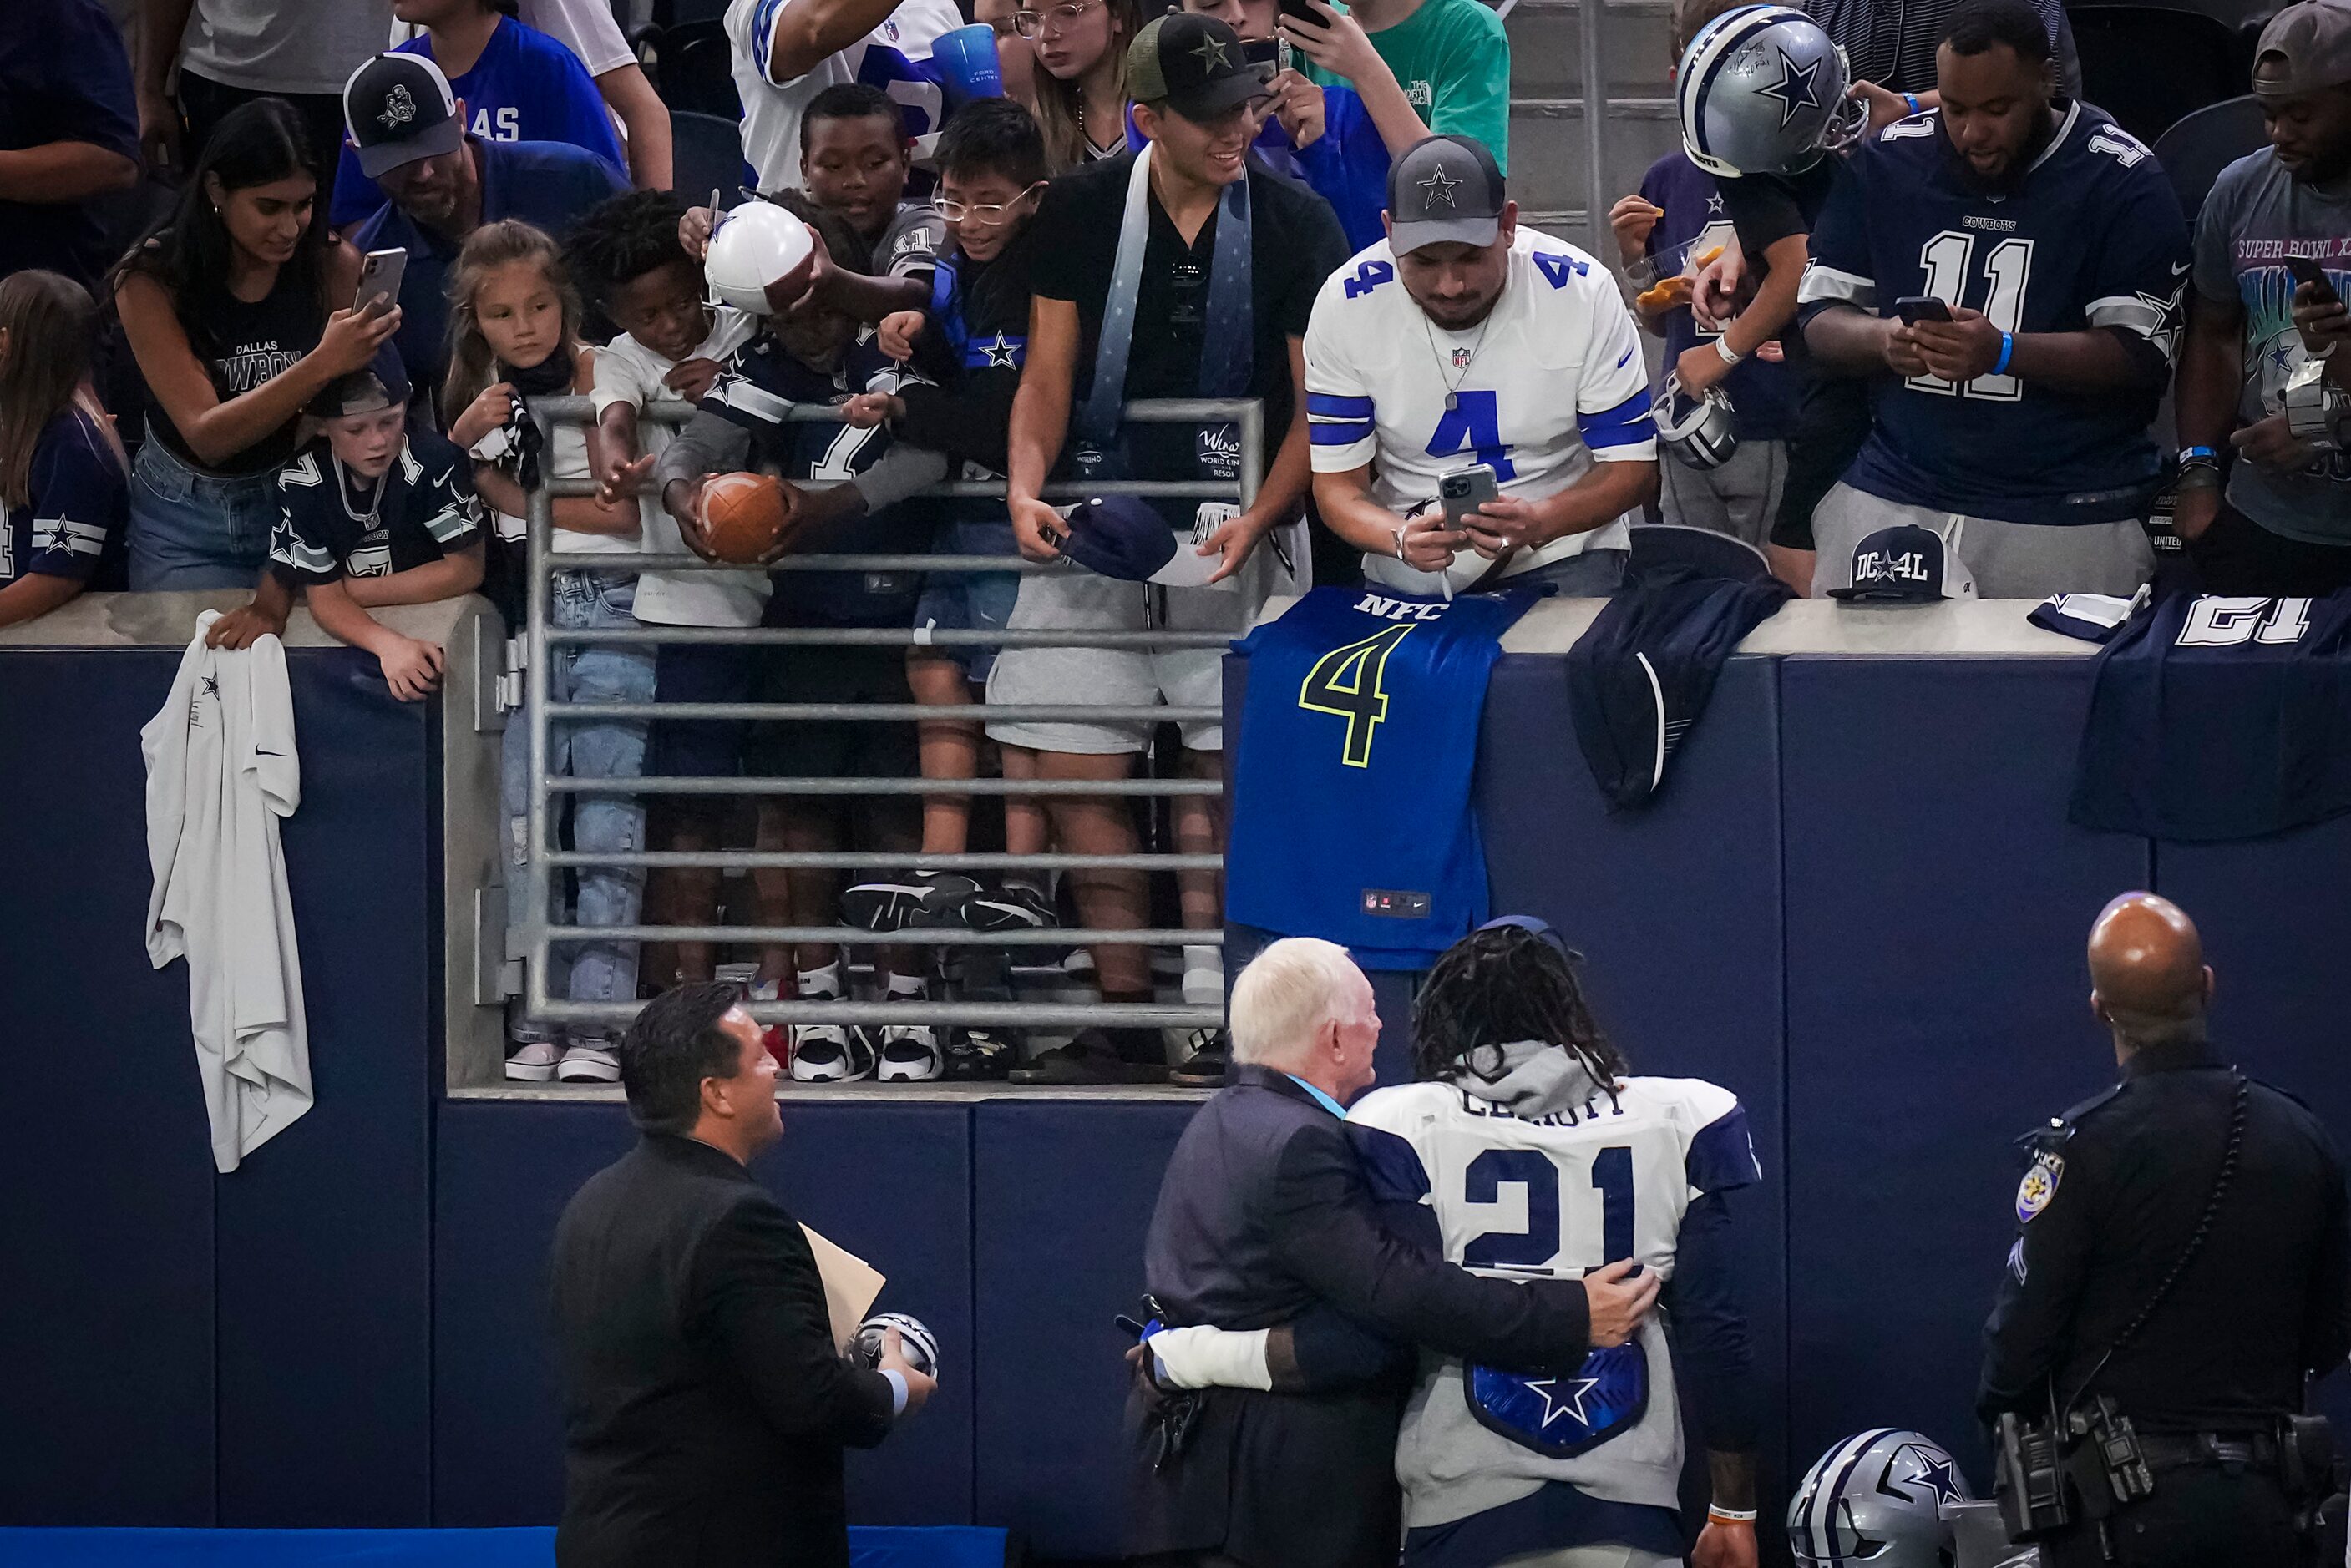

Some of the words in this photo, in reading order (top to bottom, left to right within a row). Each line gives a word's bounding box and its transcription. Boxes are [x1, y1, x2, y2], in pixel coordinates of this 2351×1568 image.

[1962, 215, 2017, 232] COWBOYS
[2238, 239, 2283, 259] SUPER
[2289, 238, 2334, 260] BOWL
[1343, 260, 1395, 300] 4
[1532, 250, 1590, 290] 4
[1903, 230, 2034, 402] 11
[236, 340, 278, 356] DALLAS
[1454, 357, 1470, 367] NFL
[1425, 390, 1518, 483] 4
[2154, 535, 2182, 547] UNITED
[1353, 593, 1450, 620] NFC
[1298, 623, 1418, 768] 4
[1462, 1146, 1635, 1267] 21
